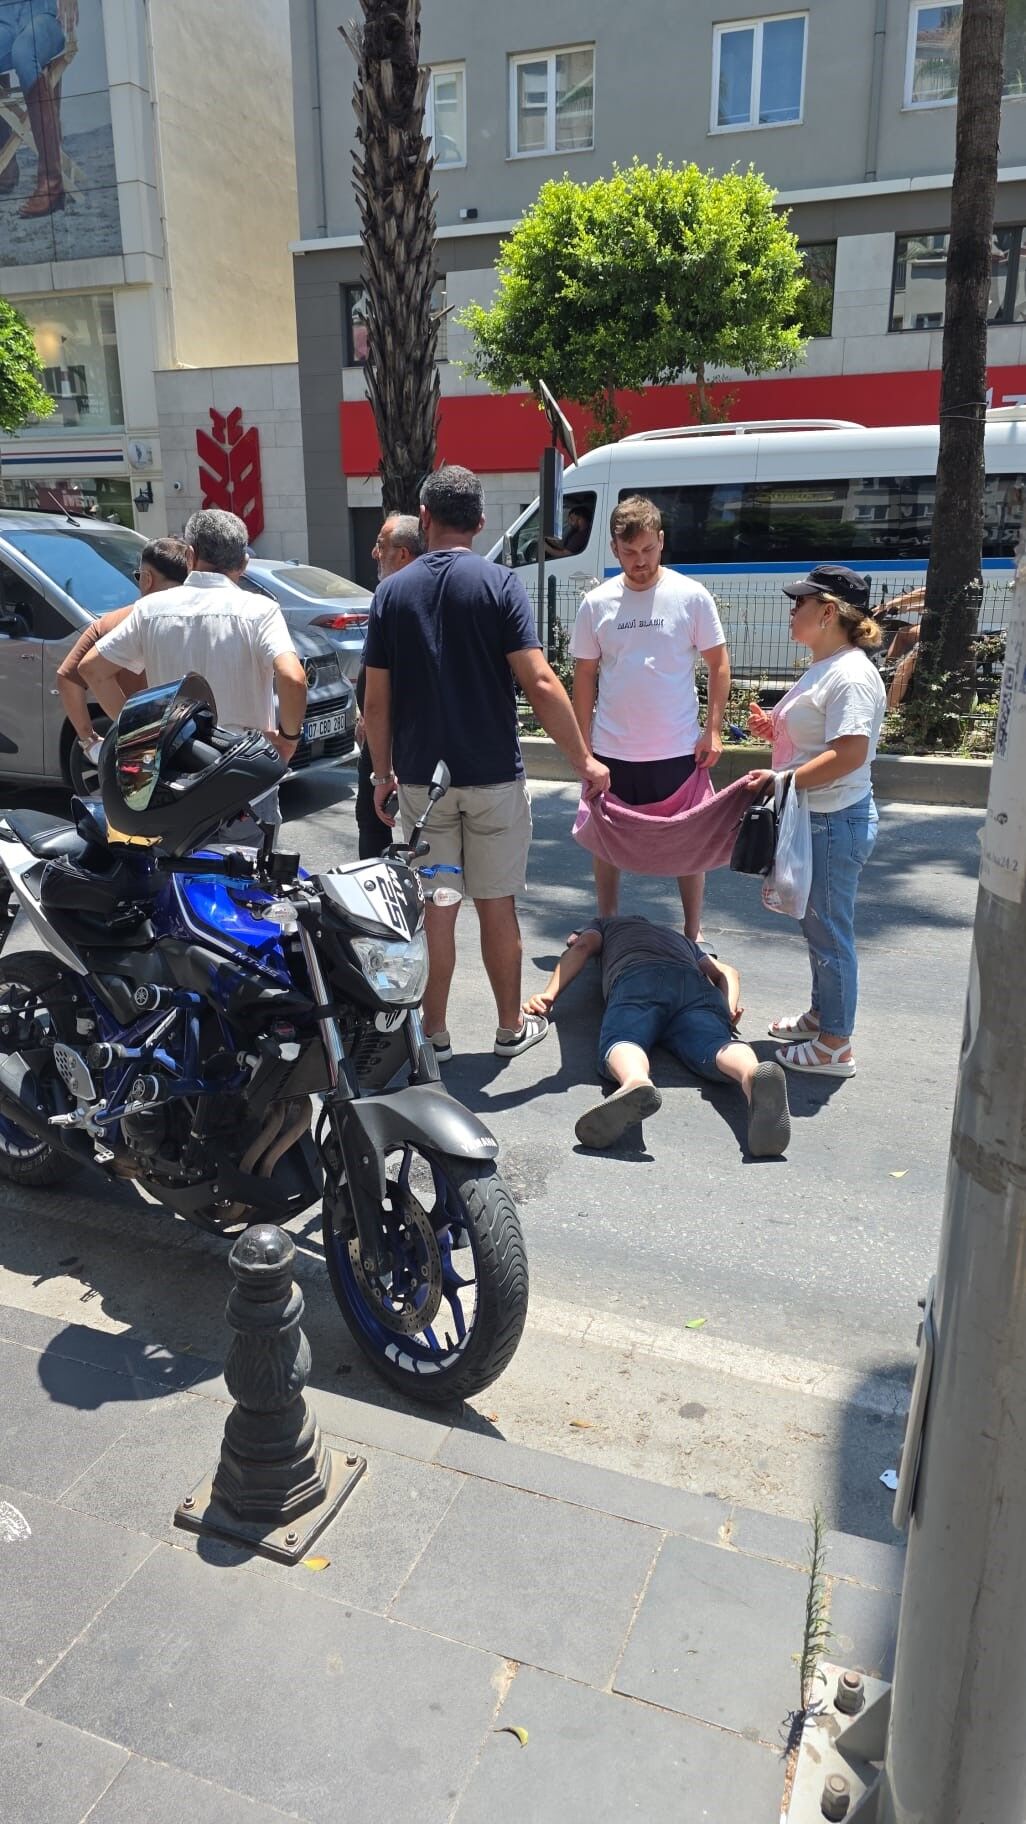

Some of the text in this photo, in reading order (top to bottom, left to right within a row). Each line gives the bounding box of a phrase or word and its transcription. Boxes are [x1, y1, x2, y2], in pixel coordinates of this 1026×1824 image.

[308, 723, 317, 738] 07
[376, 865, 408, 932] MT 25
